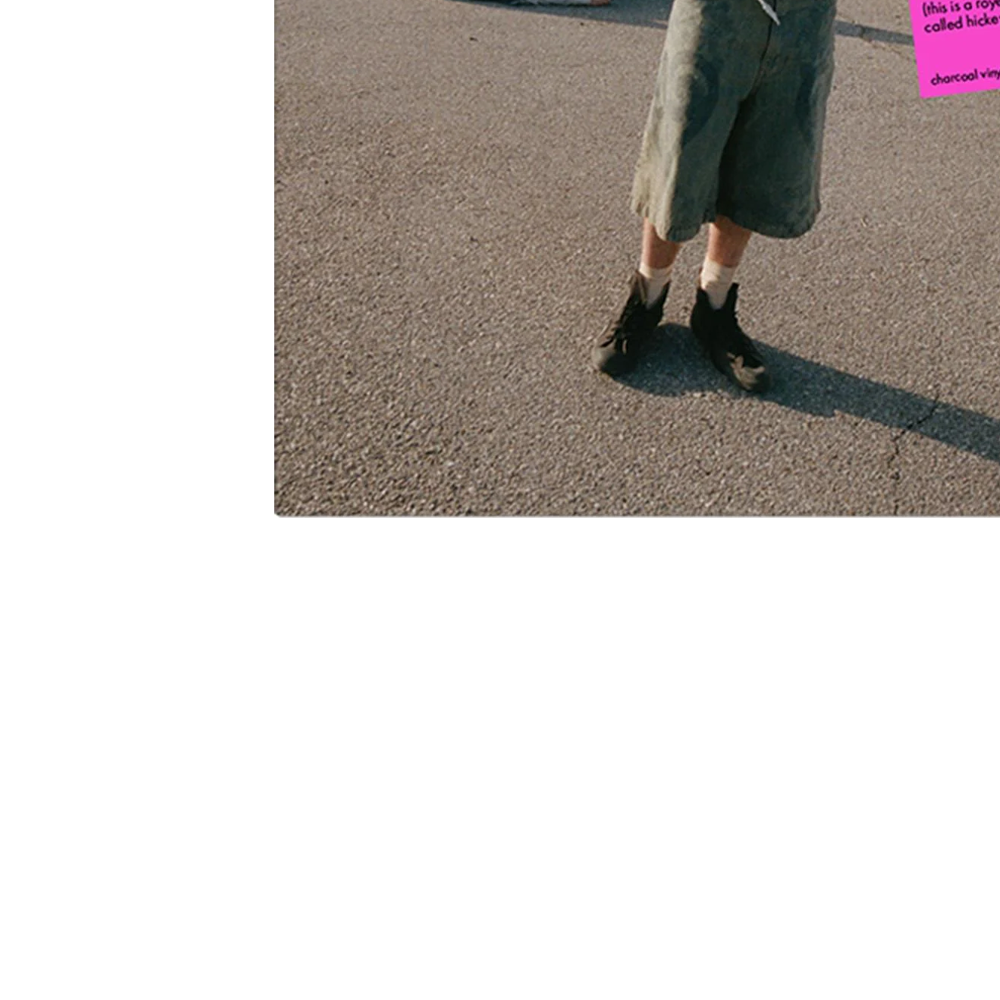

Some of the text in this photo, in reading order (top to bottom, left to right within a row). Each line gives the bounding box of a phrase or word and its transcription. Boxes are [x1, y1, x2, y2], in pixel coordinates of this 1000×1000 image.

[922, 1, 948, 18] (this
[950, 0, 961, 13] is
[963, 1, 973, 11] a
[924, 16, 964, 34] called
[930, 68, 979, 86] charcoal
